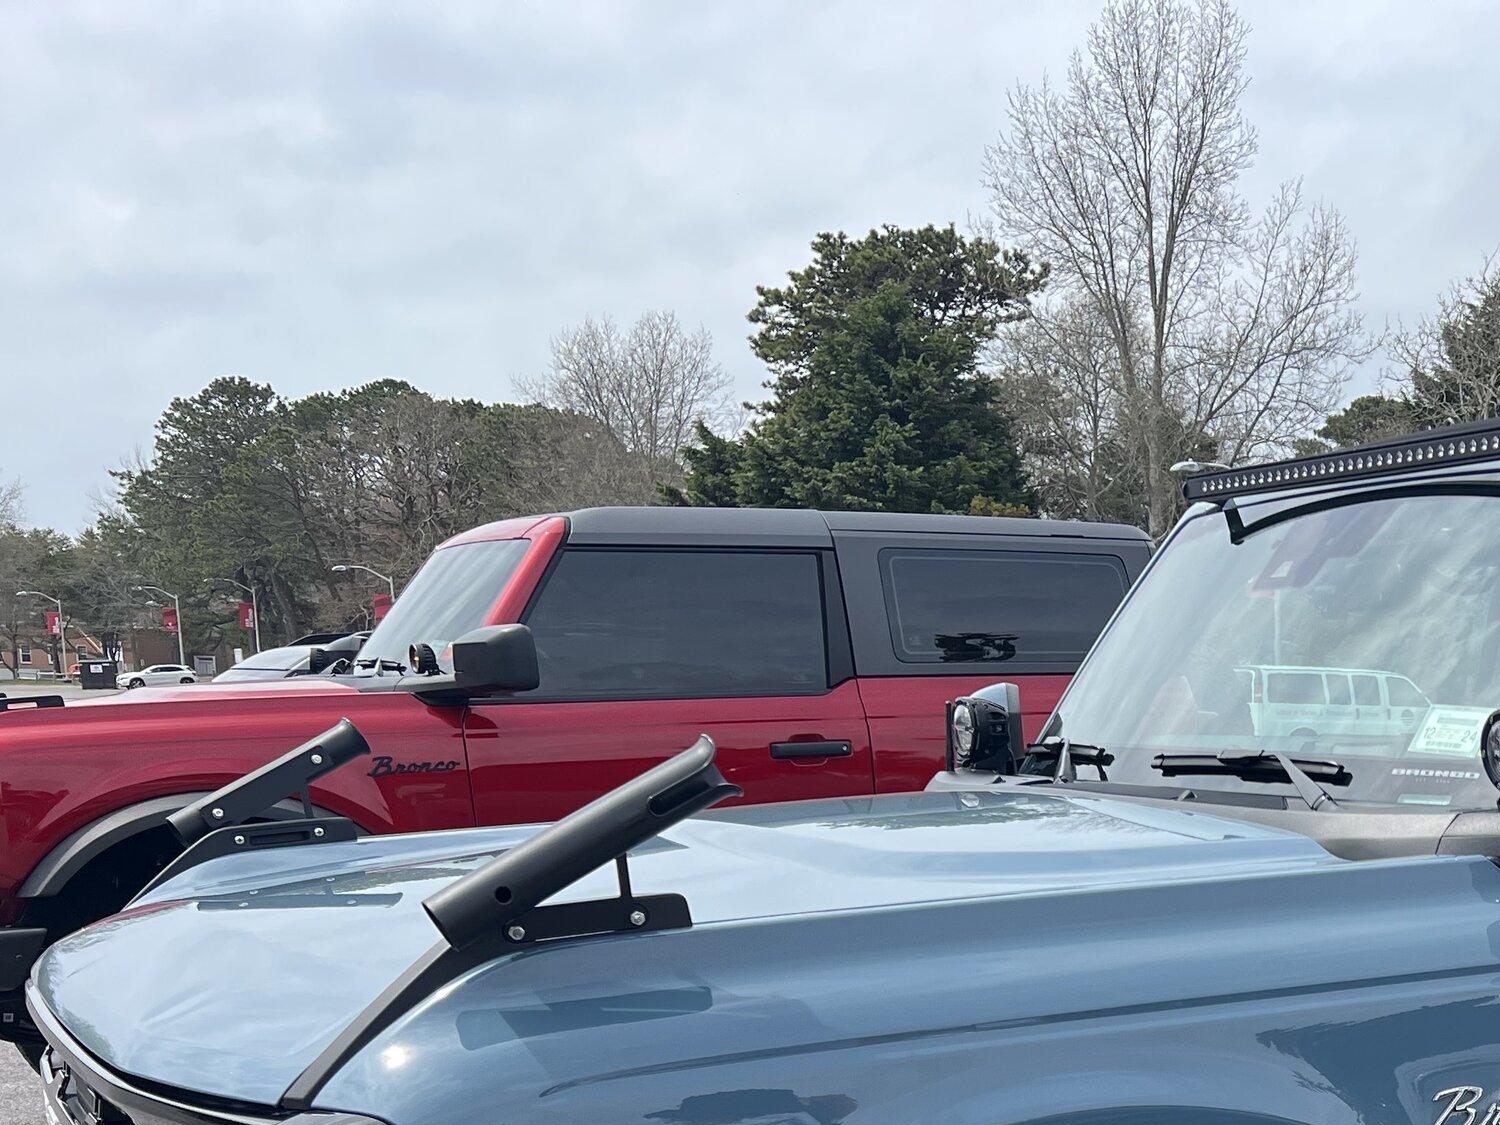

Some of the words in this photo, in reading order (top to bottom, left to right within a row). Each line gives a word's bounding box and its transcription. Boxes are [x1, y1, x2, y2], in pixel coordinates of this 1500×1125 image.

[1424, 726, 1436, 739] 12
[1461, 730, 1478, 743] 24
[367, 756, 460, 777] Bronco
